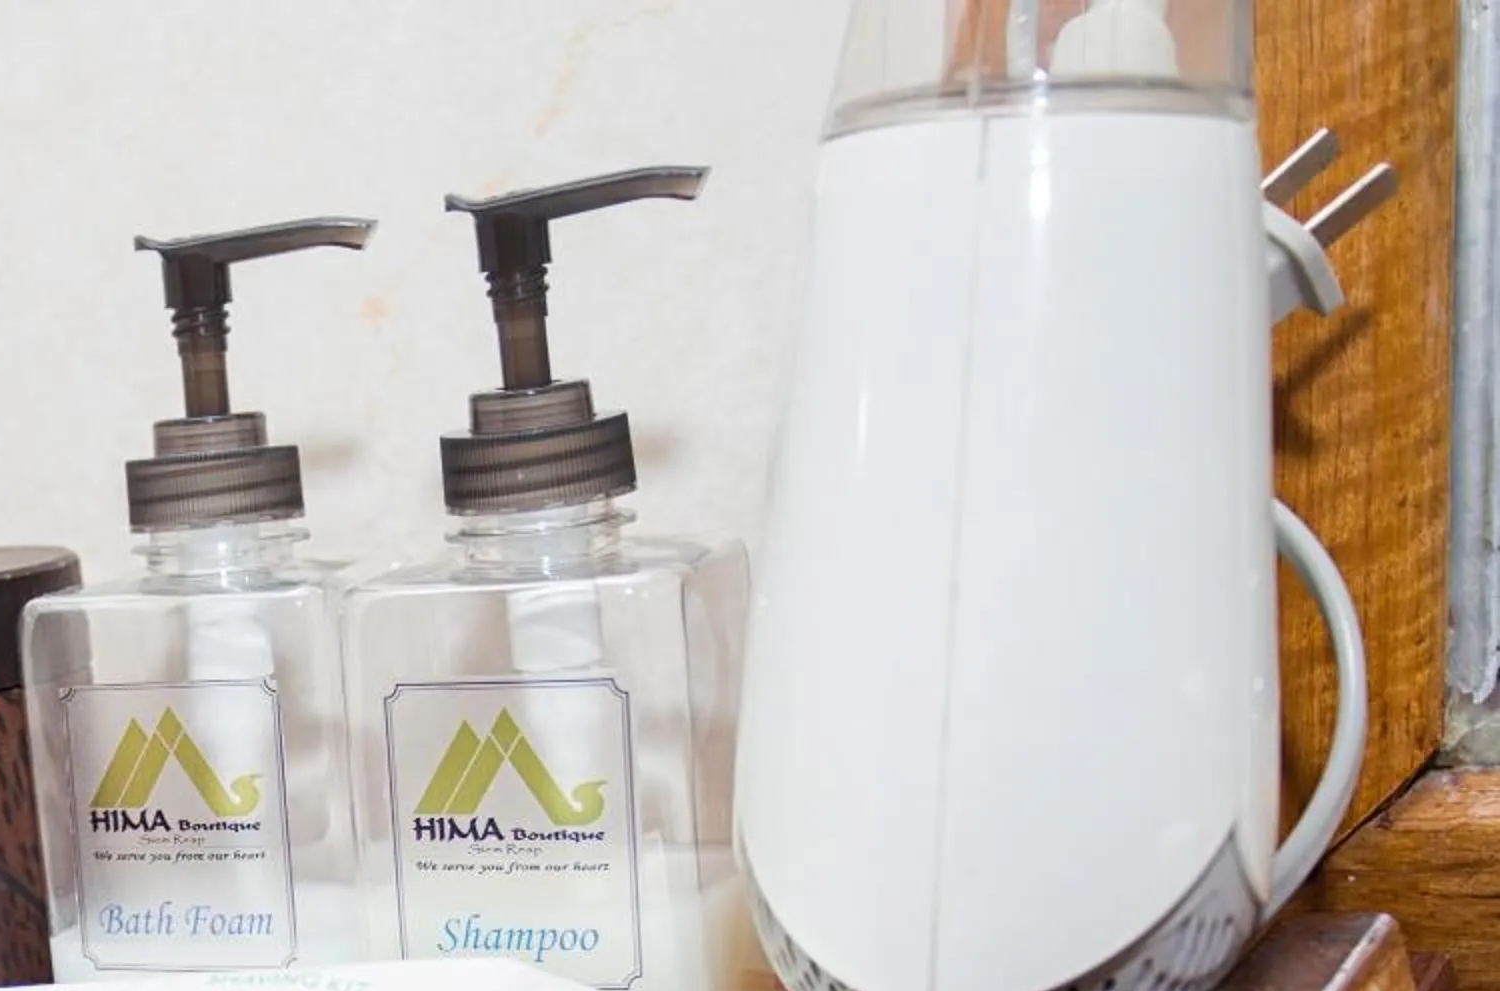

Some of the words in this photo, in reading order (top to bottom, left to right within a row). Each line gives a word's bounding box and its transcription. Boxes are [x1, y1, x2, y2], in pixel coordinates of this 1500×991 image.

[89, 808, 171, 833] HIMA
[177, 819, 262, 833] Boutique
[413, 816, 504, 842] HIMA
[511, 828, 605, 843] Boutique
[150, 852, 172, 865] you
[208, 852, 229, 861] our
[479, 862, 504, 874] you
[506, 860, 541, 875] from
[100, 901, 173, 936] Bath
[185, 903, 274, 936] Foam
[437, 913, 599, 963] Shampoo
